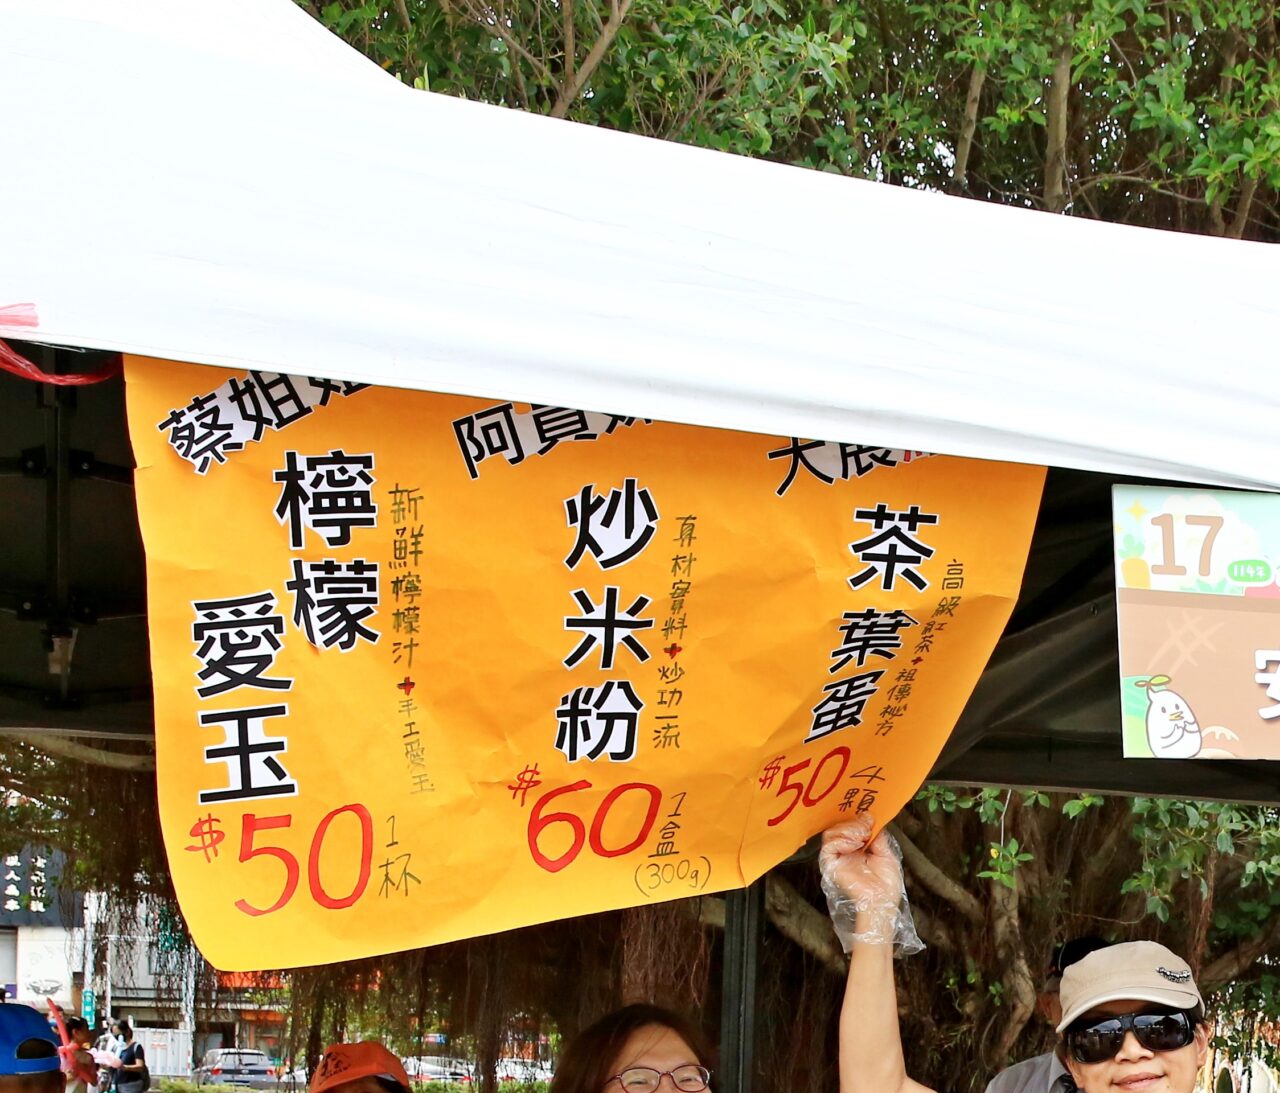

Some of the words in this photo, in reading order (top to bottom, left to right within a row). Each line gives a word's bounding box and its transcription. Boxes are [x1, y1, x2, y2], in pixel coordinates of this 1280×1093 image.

[274, 450, 379, 651] 檸檬
[555, 478, 659, 762] 炒米粉
[804, 503, 938, 744] 茶葉蛋
[1150, 512, 1225, 577] 17
[193, 592, 296, 803] 愛玉
